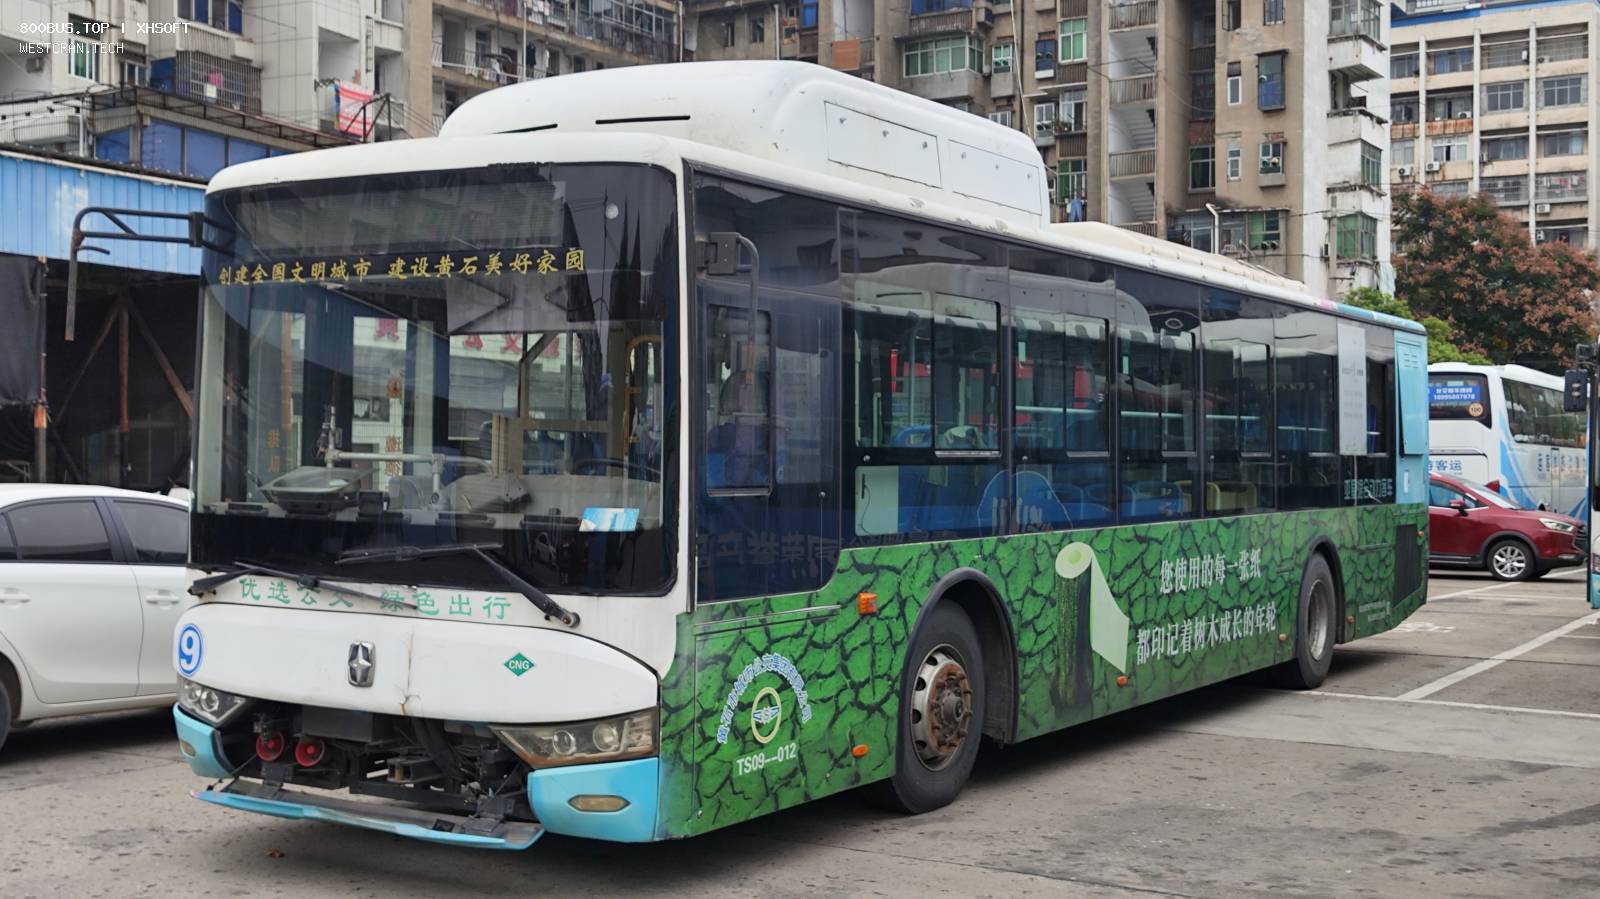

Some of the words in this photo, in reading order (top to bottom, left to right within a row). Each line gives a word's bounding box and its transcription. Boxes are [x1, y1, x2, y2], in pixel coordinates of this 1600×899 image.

[218, 258, 373, 287] 创建全国文明城市
[388, 247, 585, 280] 建设黄石美好家园
[1159, 547, 1262, 594] 您使用的每一张纸
[379, 589, 512, 621] 绿色出行
[180, 629, 200, 671] 9
[1136, 600, 1278, 665] 都印记着树木成长的年轮
[508, 660, 530, 671] CNG
